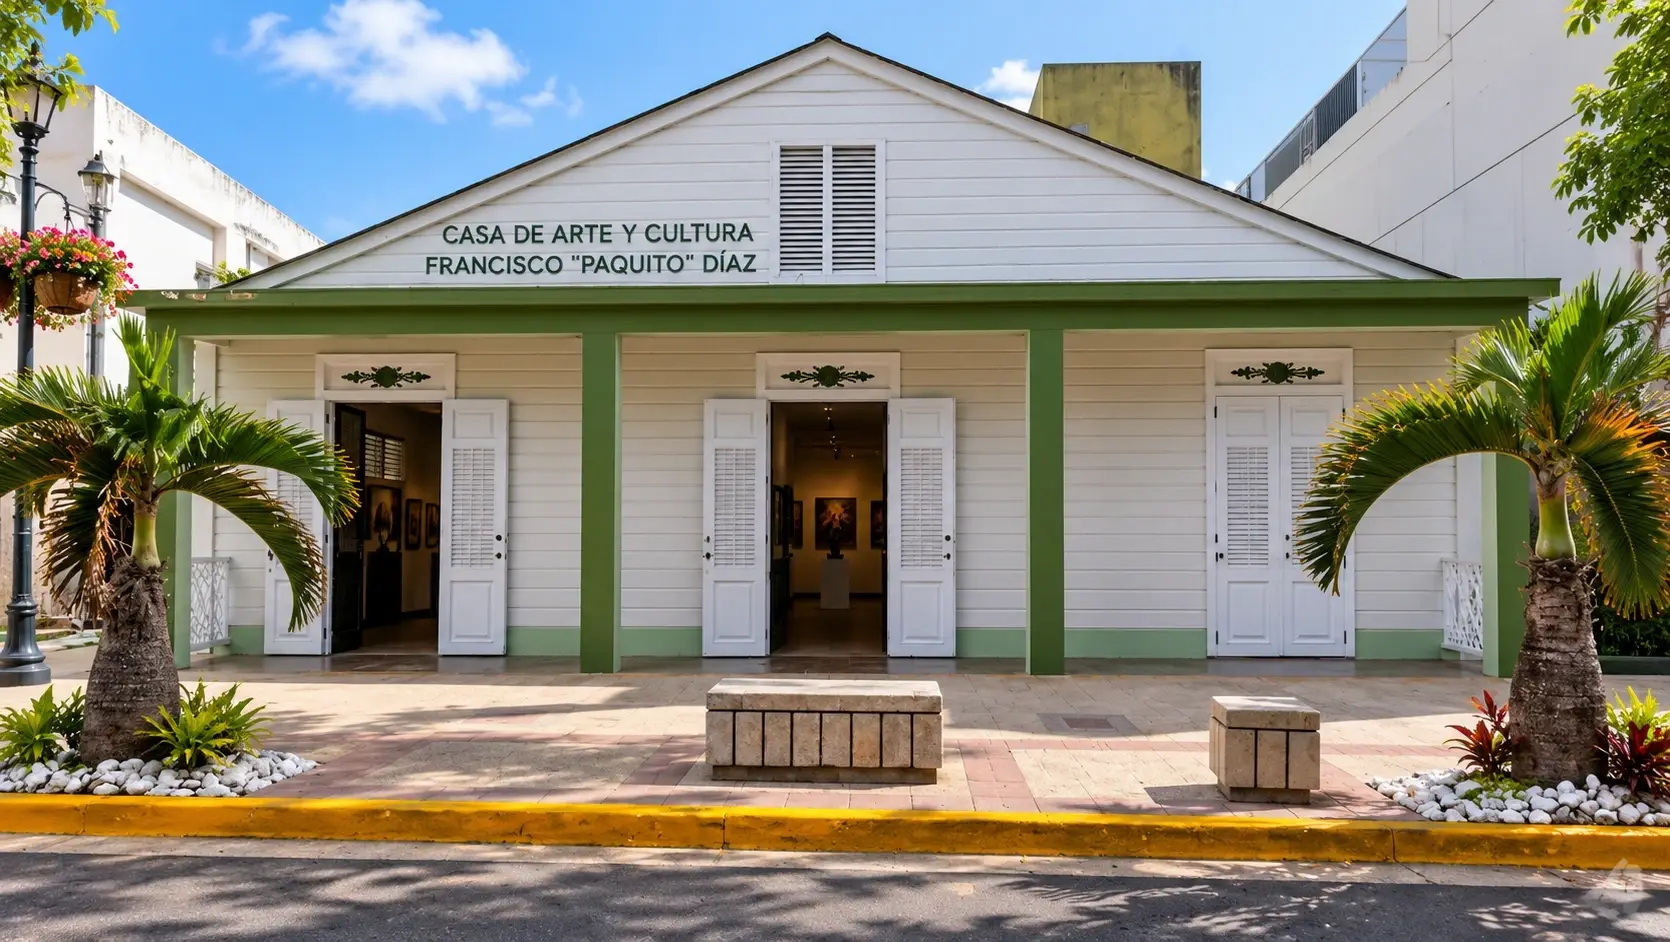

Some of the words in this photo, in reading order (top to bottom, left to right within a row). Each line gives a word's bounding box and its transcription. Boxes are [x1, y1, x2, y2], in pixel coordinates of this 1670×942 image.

[442, 224, 505, 245] CASA
[513, 223, 545, 245] DE
[551, 223, 613, 244] ARTE
[620, 223, 638, 244] Y
[644, 222, 755, 243] CULTURA
[425, 255, 564, 275] FRANCISCO
[571, 254, 695, 275] "PAQUITO"
[702, 249, 758, 273] DÍAZ
